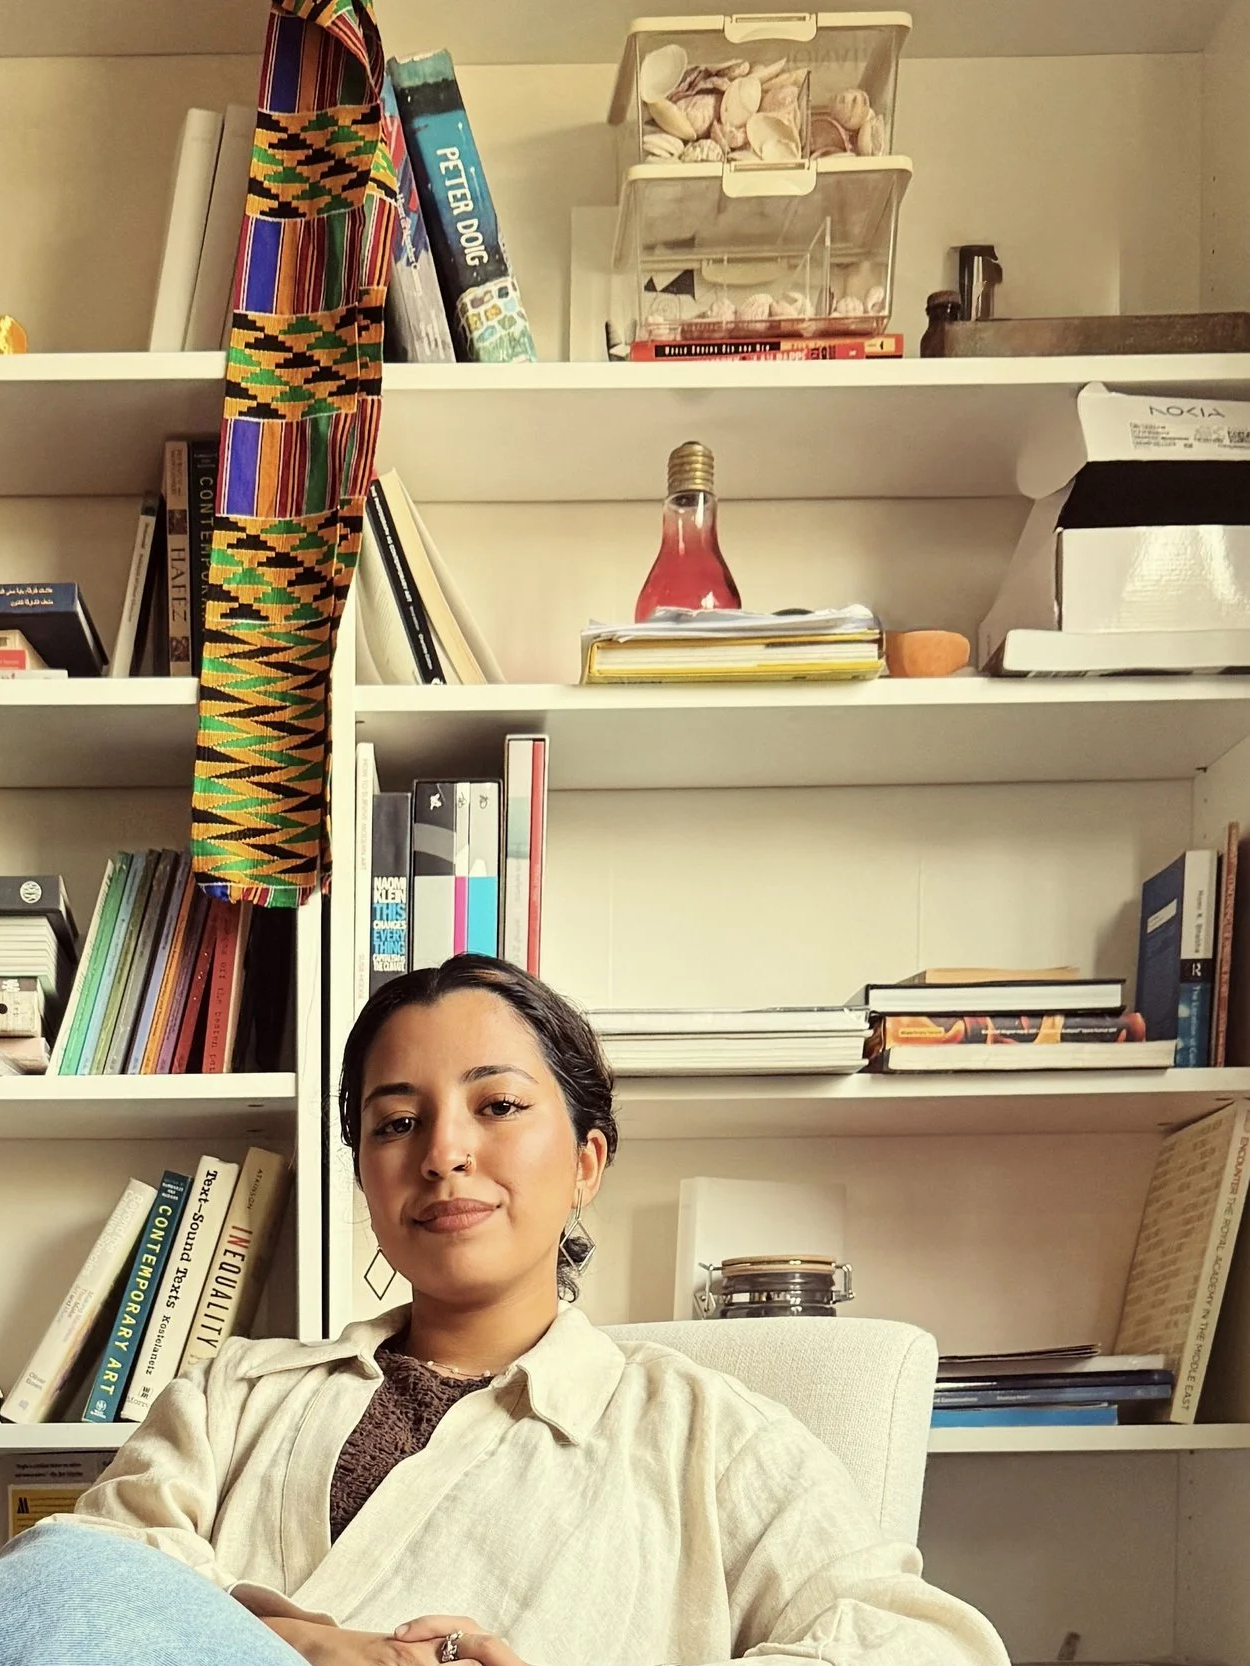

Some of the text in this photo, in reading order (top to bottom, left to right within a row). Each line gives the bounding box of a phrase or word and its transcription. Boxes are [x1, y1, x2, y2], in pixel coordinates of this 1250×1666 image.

[436, 147, 488, 266] PETER DOIG
[1150, 406, 1225, 418] NOKIA
[369, 484, 413, 603] THE PHOTOGRAPH AS CONTEMPORARY ART
[170, 547, 186, 622] HAFEZ
[359, 758, 369, 870] HOW TO SURVIVE MODERN ART
[373, 876, 407, 889] NAOMI
[373, 889, 407, 903] KLEIN
[373, 903, 406, 920] THIS
[373, 920, 406, 929] CHANGES
[374, 929, 406, 941] EVERY
[374, 941, 406, 955] THING
[210, 962, 226, 1048] off the beaten
[1189, 985, 1201, 1046] The Location of
[244, 1168, 264, 1210] ATKINSON
[80, 1187, 135, 1279] Creative Species
[104, 1191, 144, 1255] Beyond the
[97, 1202, 172, 1397] CONTEMPORARY ART
[164, 1265, 189, 1309] Texts
[194, 1223, 254, 1347] INEQUALITY
[1180, 1136, 1249, 1410] ENCOUNTER THE ROYAL ACADEMY IN THE MIDDLE EAST
[142, 1313, 173, 1376] Kostelanetz
